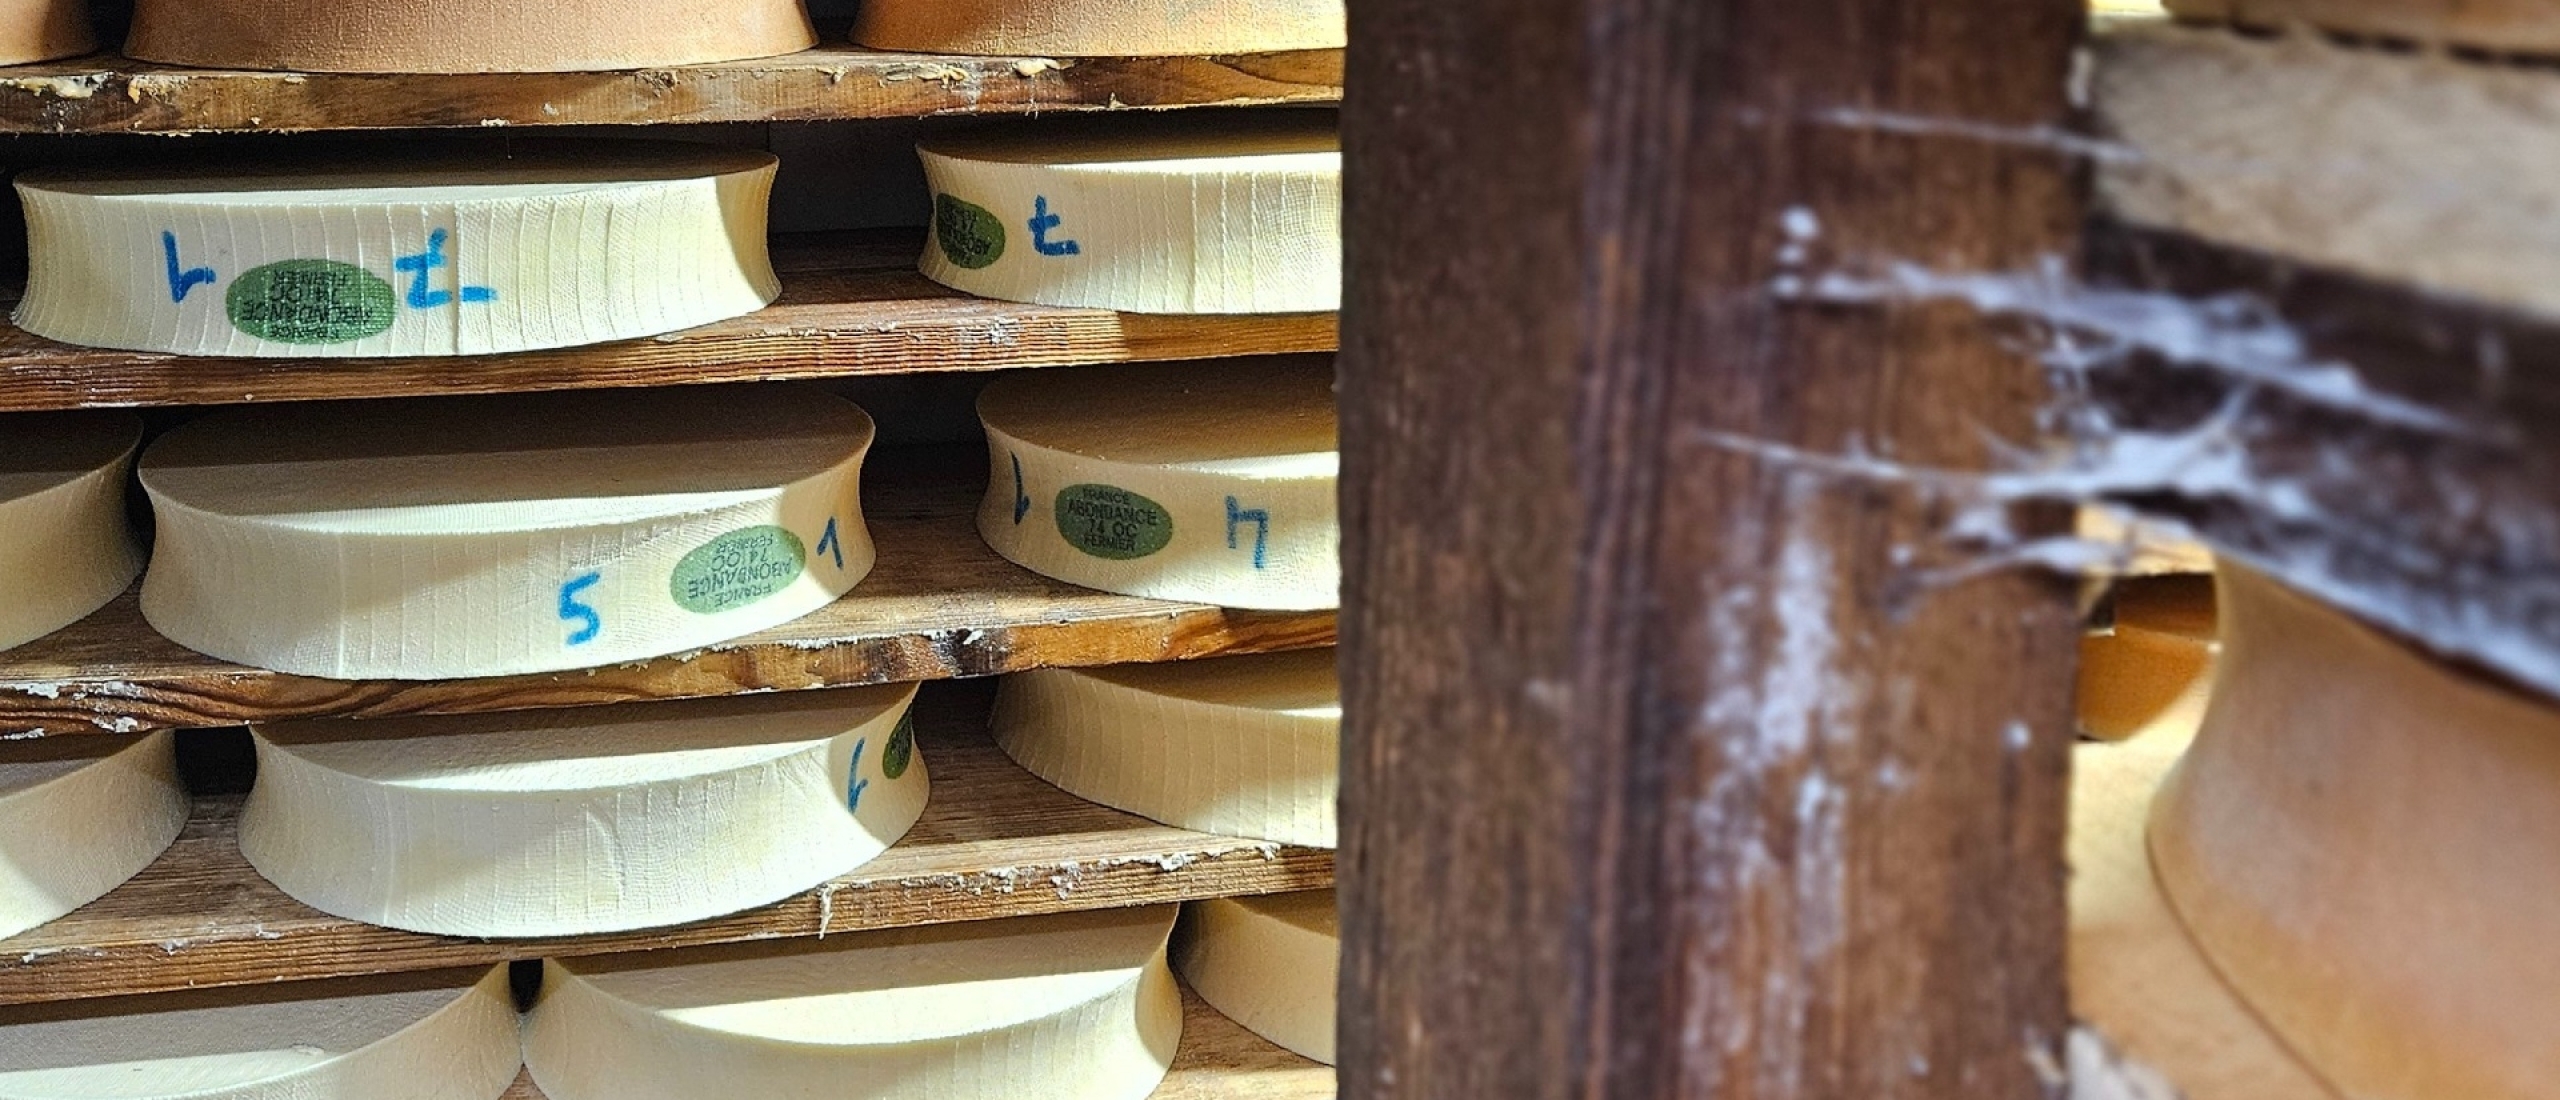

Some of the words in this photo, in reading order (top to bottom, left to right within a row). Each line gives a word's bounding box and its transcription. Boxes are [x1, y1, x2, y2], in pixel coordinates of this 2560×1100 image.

[1082, 486, 1130, 506] FRANCE
[1067, 498, 1157, 527] ABONDANCE
[1087, 518, 1105, 534] 74
[1112, 520, 1138, 538] OC
[715, 533, 774, 554] FERMIER
[1083, 533, 1136, 553] FERMIER
[711, 551, 742, 572] OC
[749, 547, 769, 564] 74
[687, 556, 793, 600] ABONDANCE
[714, 583, 772, 608] FRANCE
[559, 571, 601, 647] 5
